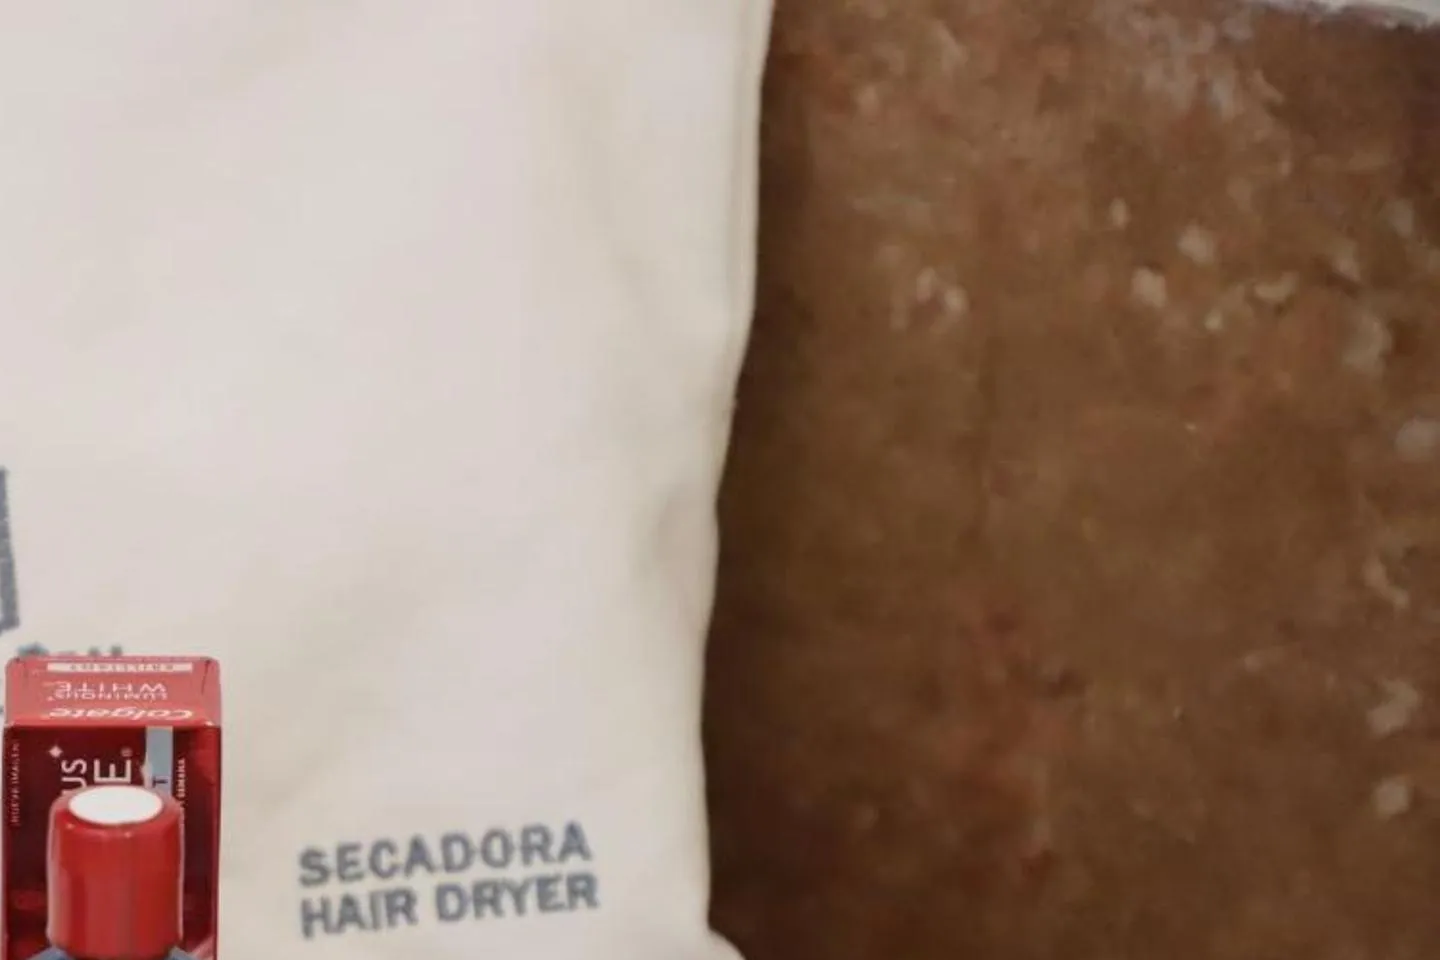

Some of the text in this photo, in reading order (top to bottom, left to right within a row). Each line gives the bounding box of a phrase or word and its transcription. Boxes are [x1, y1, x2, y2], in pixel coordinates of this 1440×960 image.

[56, 682, 167, 693] WHITE
[49, 706, 194, 721] Colgate
[298, 820, 592, 887] SECADORA
[300, 872, 600, 940] HAIR DRYER
